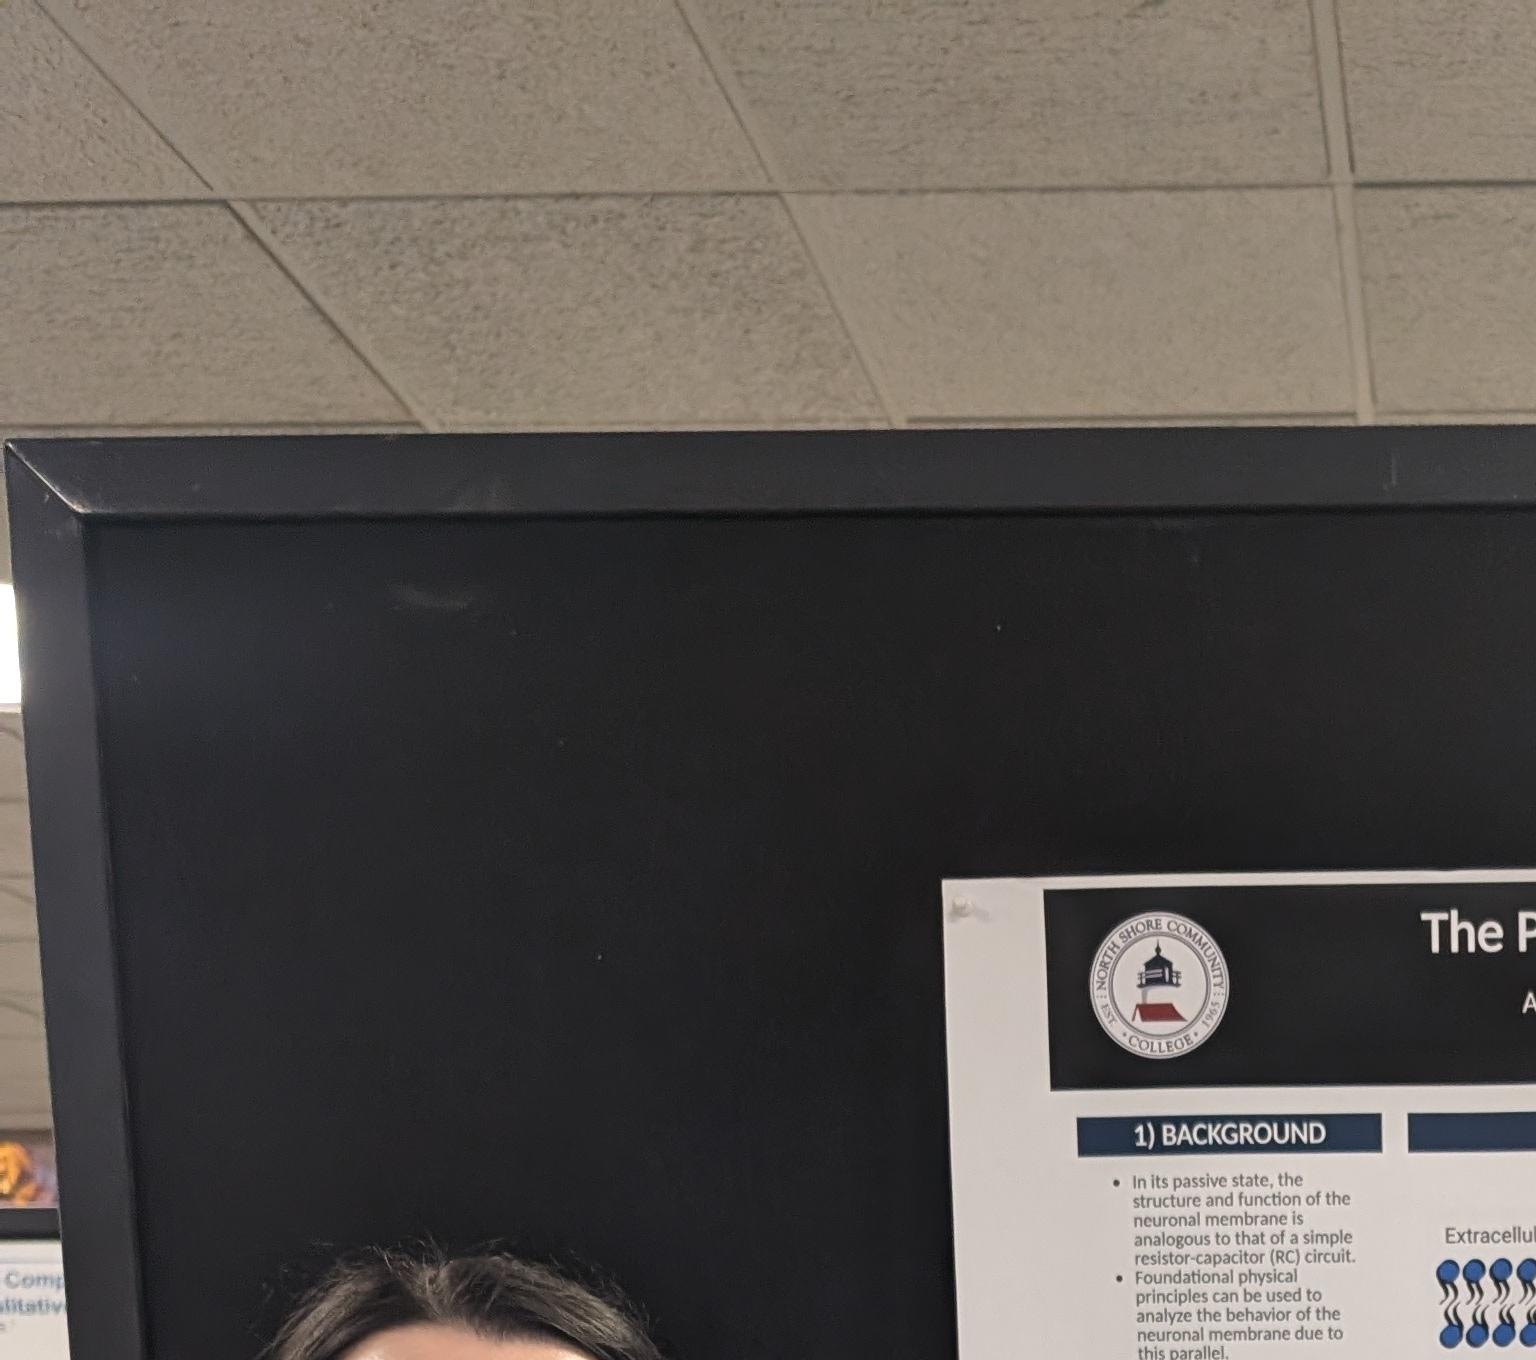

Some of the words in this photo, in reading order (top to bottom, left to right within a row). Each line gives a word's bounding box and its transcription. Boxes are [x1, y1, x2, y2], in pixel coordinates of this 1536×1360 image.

[1421, 909, 1503, 953] The
[1096, 942, 1120, 991] NORTH
[1119, 918, 1162, 944] SHORE
[1167, 919, 1224, 989] COMMUNITY
[1201, 1001, 1221, 1028] 1965
[1128, 1033, 1194, 1053] COLLEGE
[1135, 1123, 1154, 1149] 1)
[1163, 1122, 1326, 1145] BACKGROUND
[1133, 1175, 1148, 1189] In
[1152, 1174, 1169, 1189] its
[1173, 1173, 1227, 1192] passive
[1232, 1174, 1273, 1188] state,
[1278, 1172, 1303, 1186] the
[1133, 1195, 1201, 1208] structure
[1206, 1192, 1233, 1207] and
[1239, 1192, 1301, 1206] function
[1306, 1191, 1321, 1205] of
[1326, 1191, 1350, 1205] the
[1134, 1212, 1200, 1227] neuronal
[1206, 1211, 1287, 1226] membrane
[1293, 1211, 1303, 1225] is
[1134, 1232, 1210, 1249] analogous
[1215, 1232, 1230, 1245] to
[1235, 1231, 1265, 1245] that
[1270, 1230, 1285, 1244] of
[1290, 1234, 1298, 1244] a
[1303, 1230, 1352, 1247] simple
[1135, 1250, 1265, 1267] resistor-capacitor
[1270, 1249, 1300, 1266] (RC)
[1305, 1248, 1355, 1263] circuit.
[0, 1298, 67, 1315] litativ
